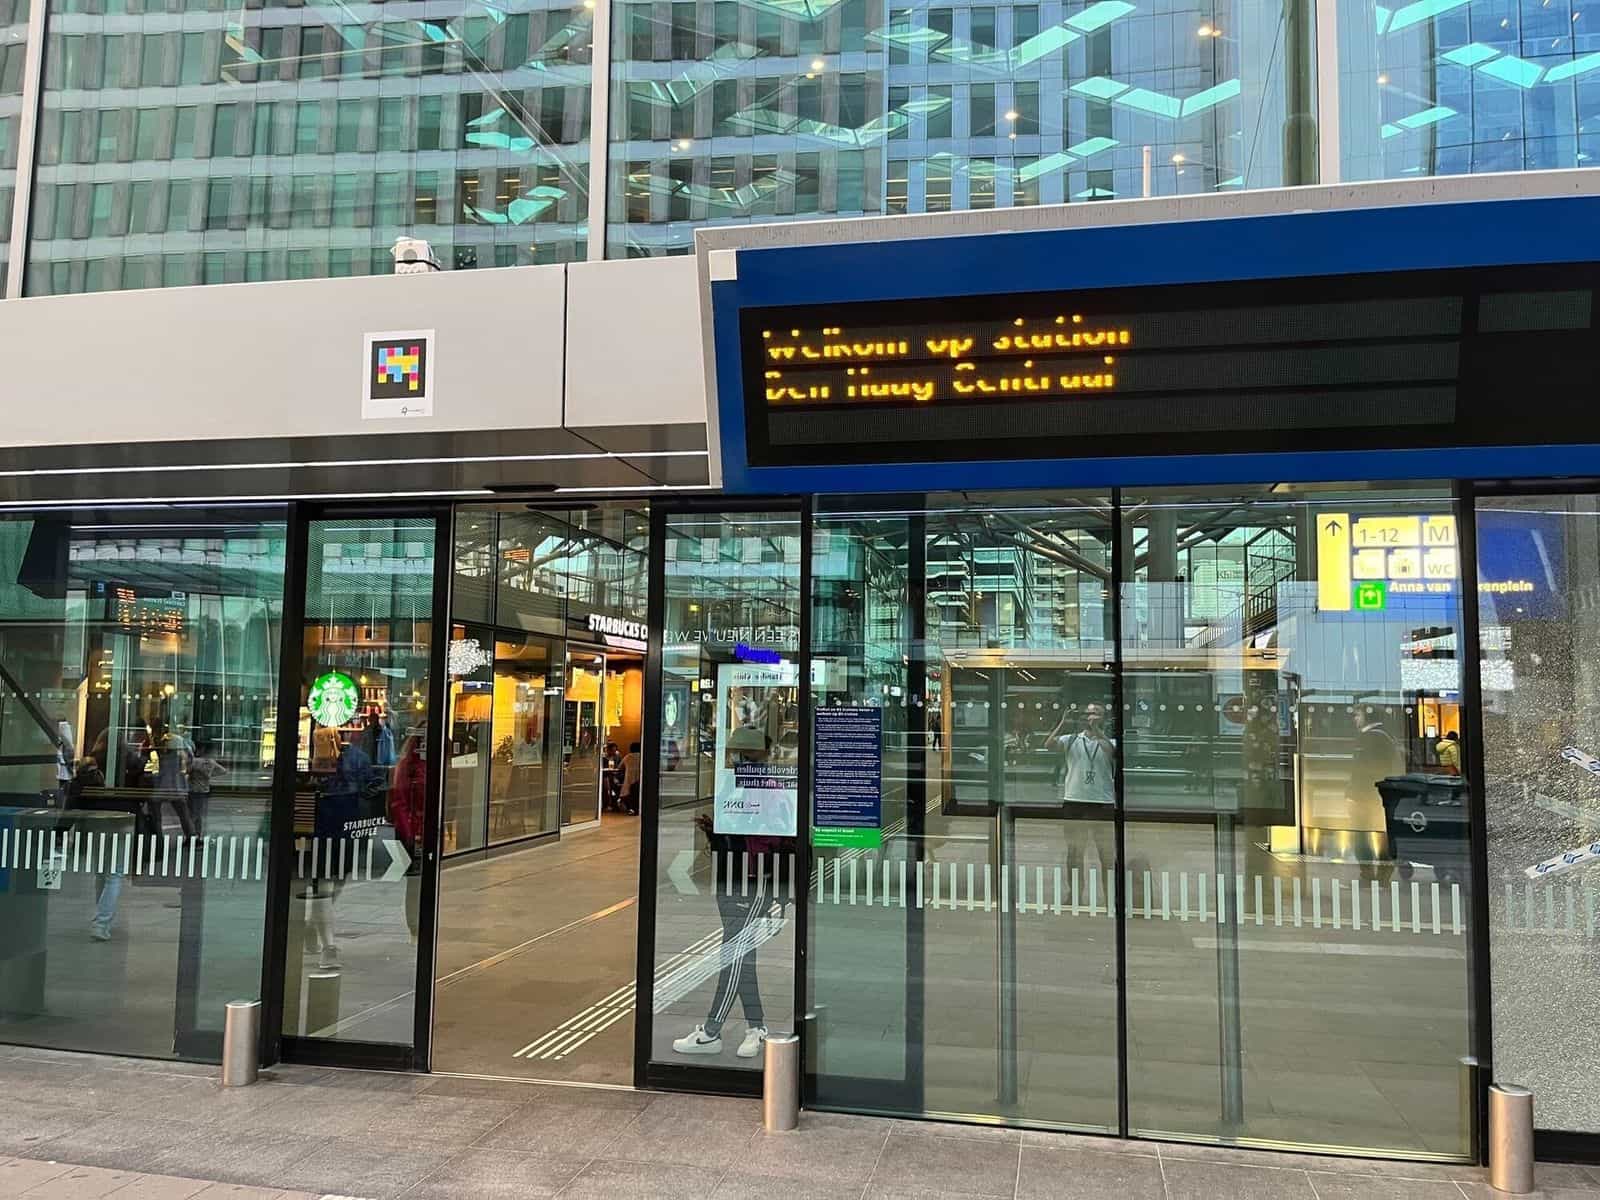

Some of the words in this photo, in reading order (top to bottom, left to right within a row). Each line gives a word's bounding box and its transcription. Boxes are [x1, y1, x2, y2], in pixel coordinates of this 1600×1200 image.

[1360, 527, 1400, 543] 1-12
[1429, 525, 1450, 542] M
[1389, 582, 1424, 593] Anna
[1426, 583, 1452, 593] van
[588, 613, 640, 639] STARBUCKS
[350, 826, 377, 839] COFFEE
